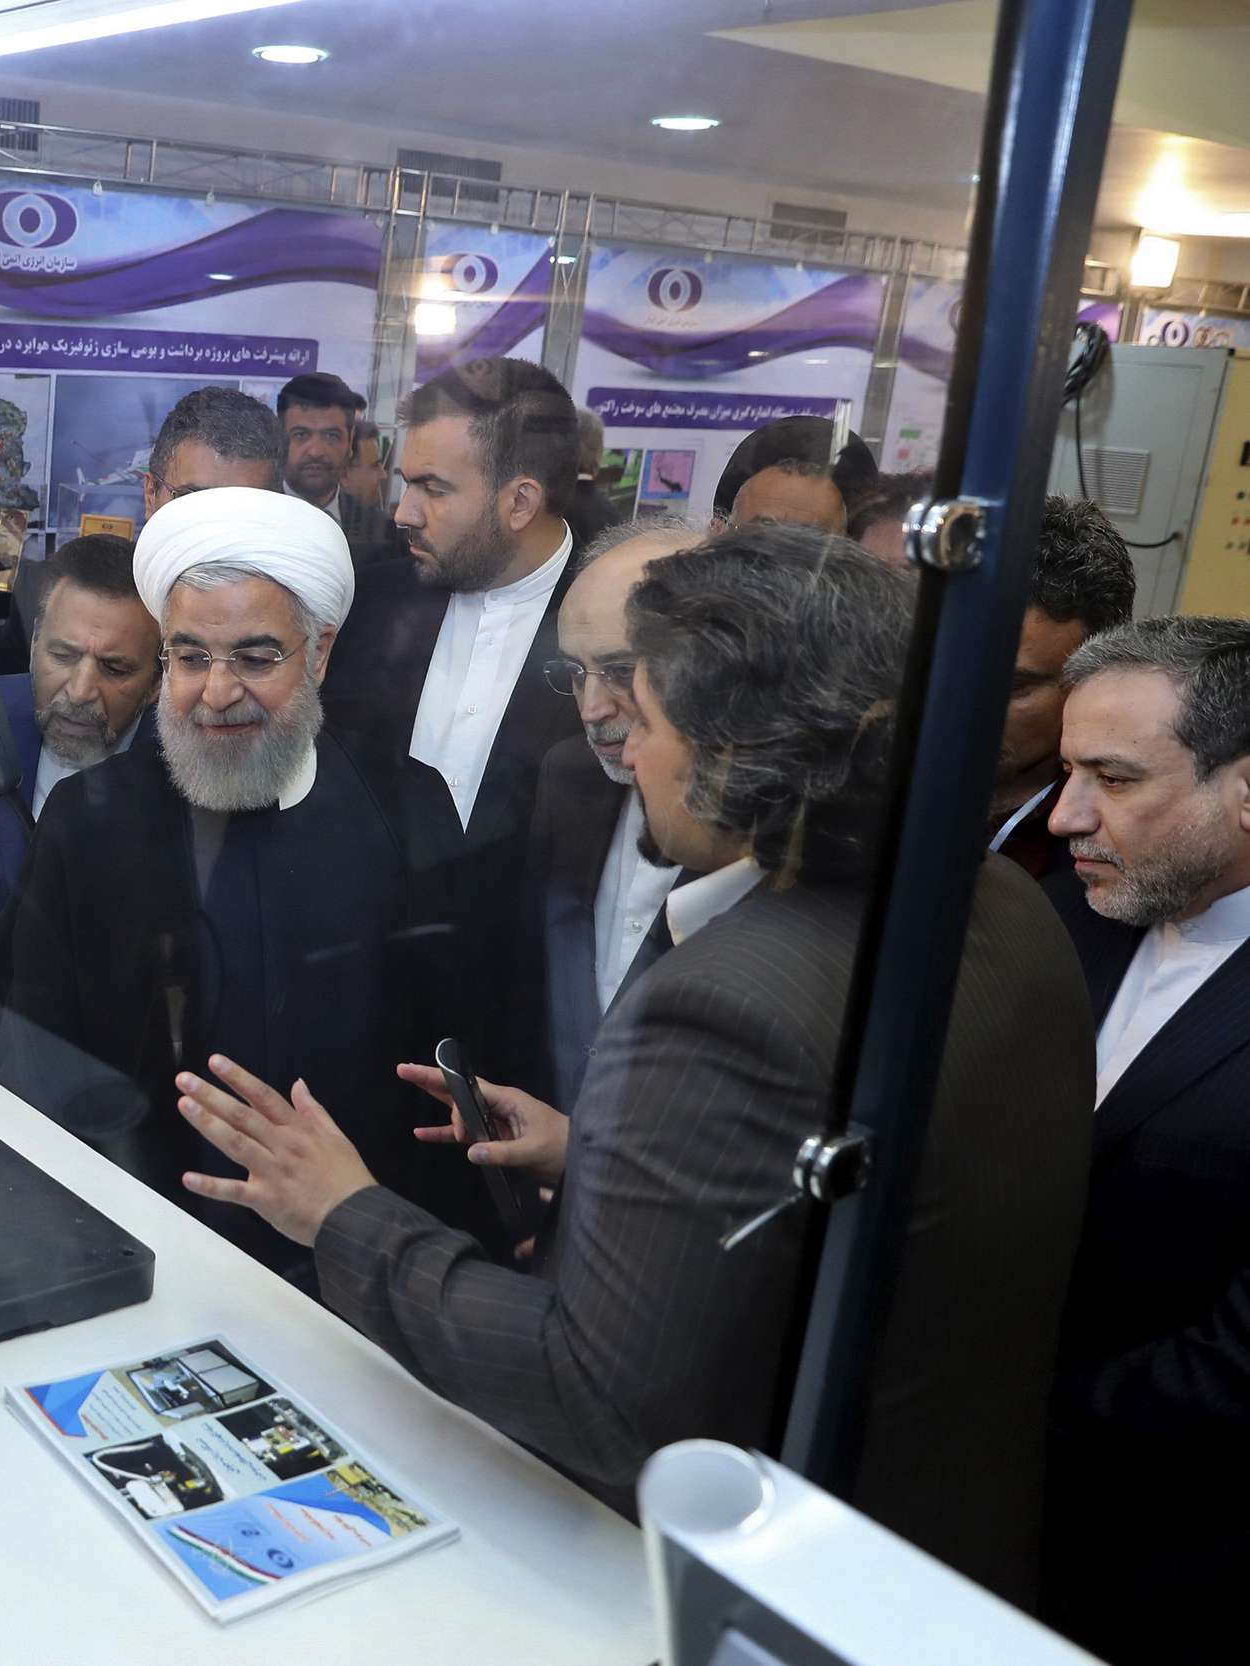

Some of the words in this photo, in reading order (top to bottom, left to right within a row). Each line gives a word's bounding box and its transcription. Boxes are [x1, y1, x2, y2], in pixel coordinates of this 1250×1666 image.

[23, 256, 44, 268] انرژی
[46, 256, 75, 270] سازمان
[0, 338, 12, 354] در
[15, 337, 49, 355] هوابرد
[52, 337, 98, 356] ژئوفیزیک
[102, 341, 128, 358] سازی
[131, 344, 156, 359] بومی
[159, 348, 165, 359] و
[168, 344, 202, 361] برداشت
[205, 347, 230, 363] پروژه
[232, 347, 250, 363] های
[254, 346, 285, 365] پیشرفت
[289, 349, 310, 365] ارائه
[621, 400, 644, 417] سوخت
[646, 401, 660, 418] های
